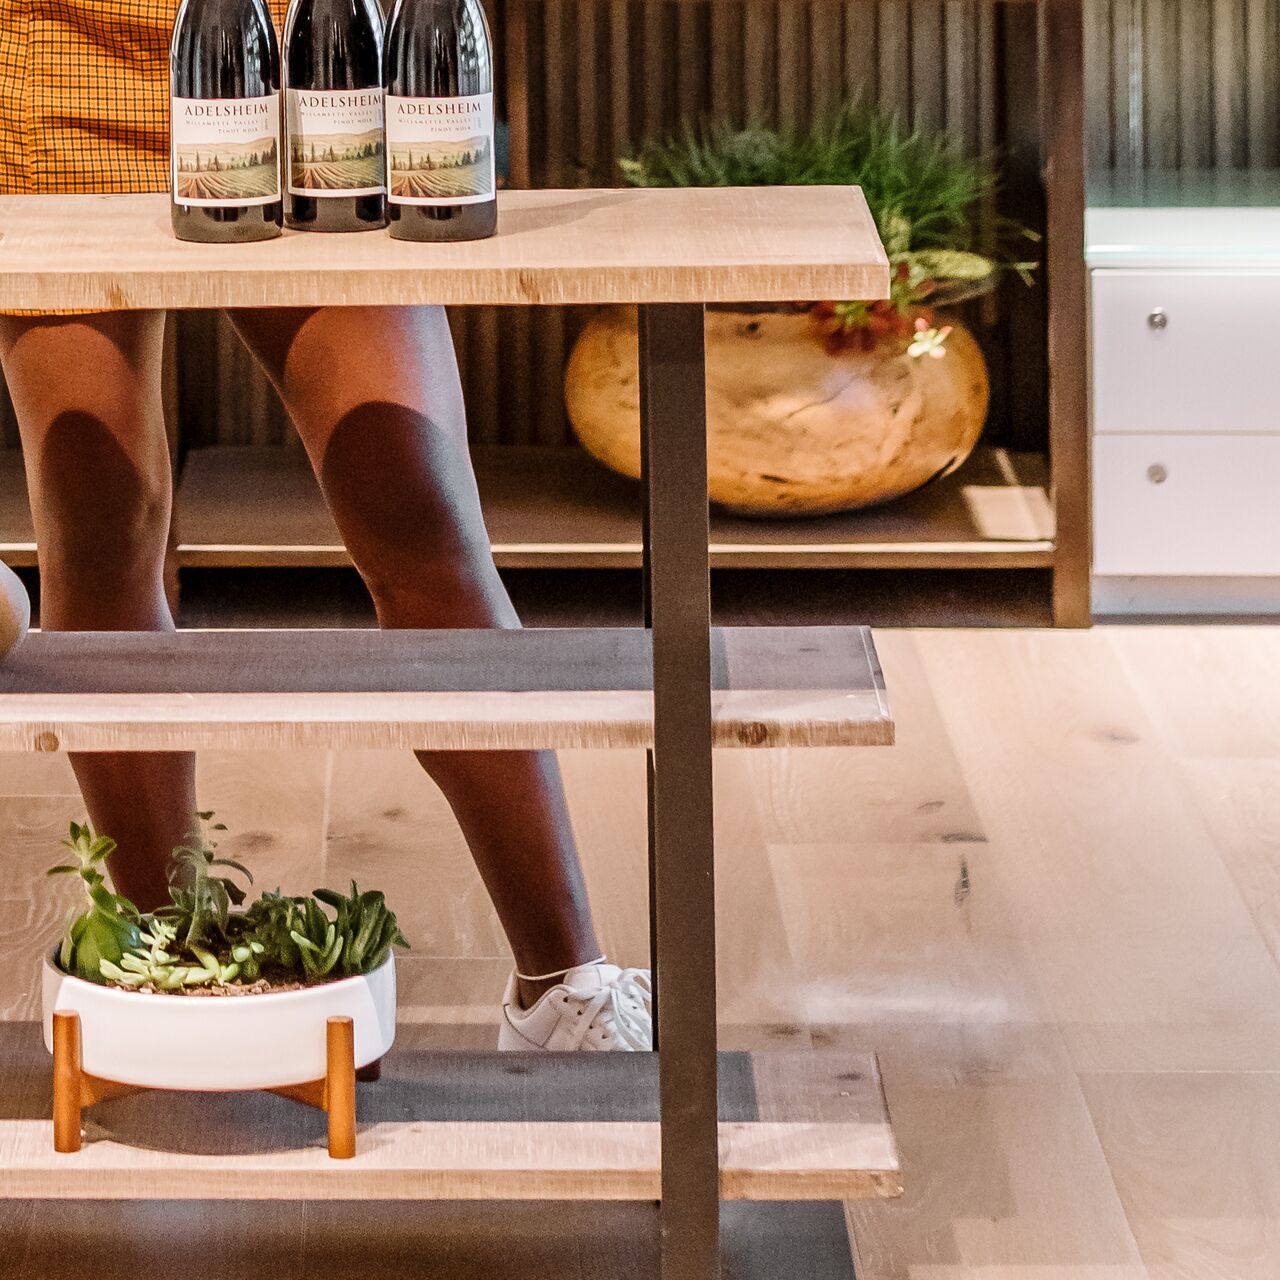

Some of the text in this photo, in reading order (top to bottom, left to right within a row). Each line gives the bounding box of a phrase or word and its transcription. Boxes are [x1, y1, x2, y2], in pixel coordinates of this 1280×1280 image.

[299, 94, 382, 108] ADELSHEIM
[184, 103, 269, 117] ADELSHEIM
[397, 102, 482, 115] ADELSHEIM
